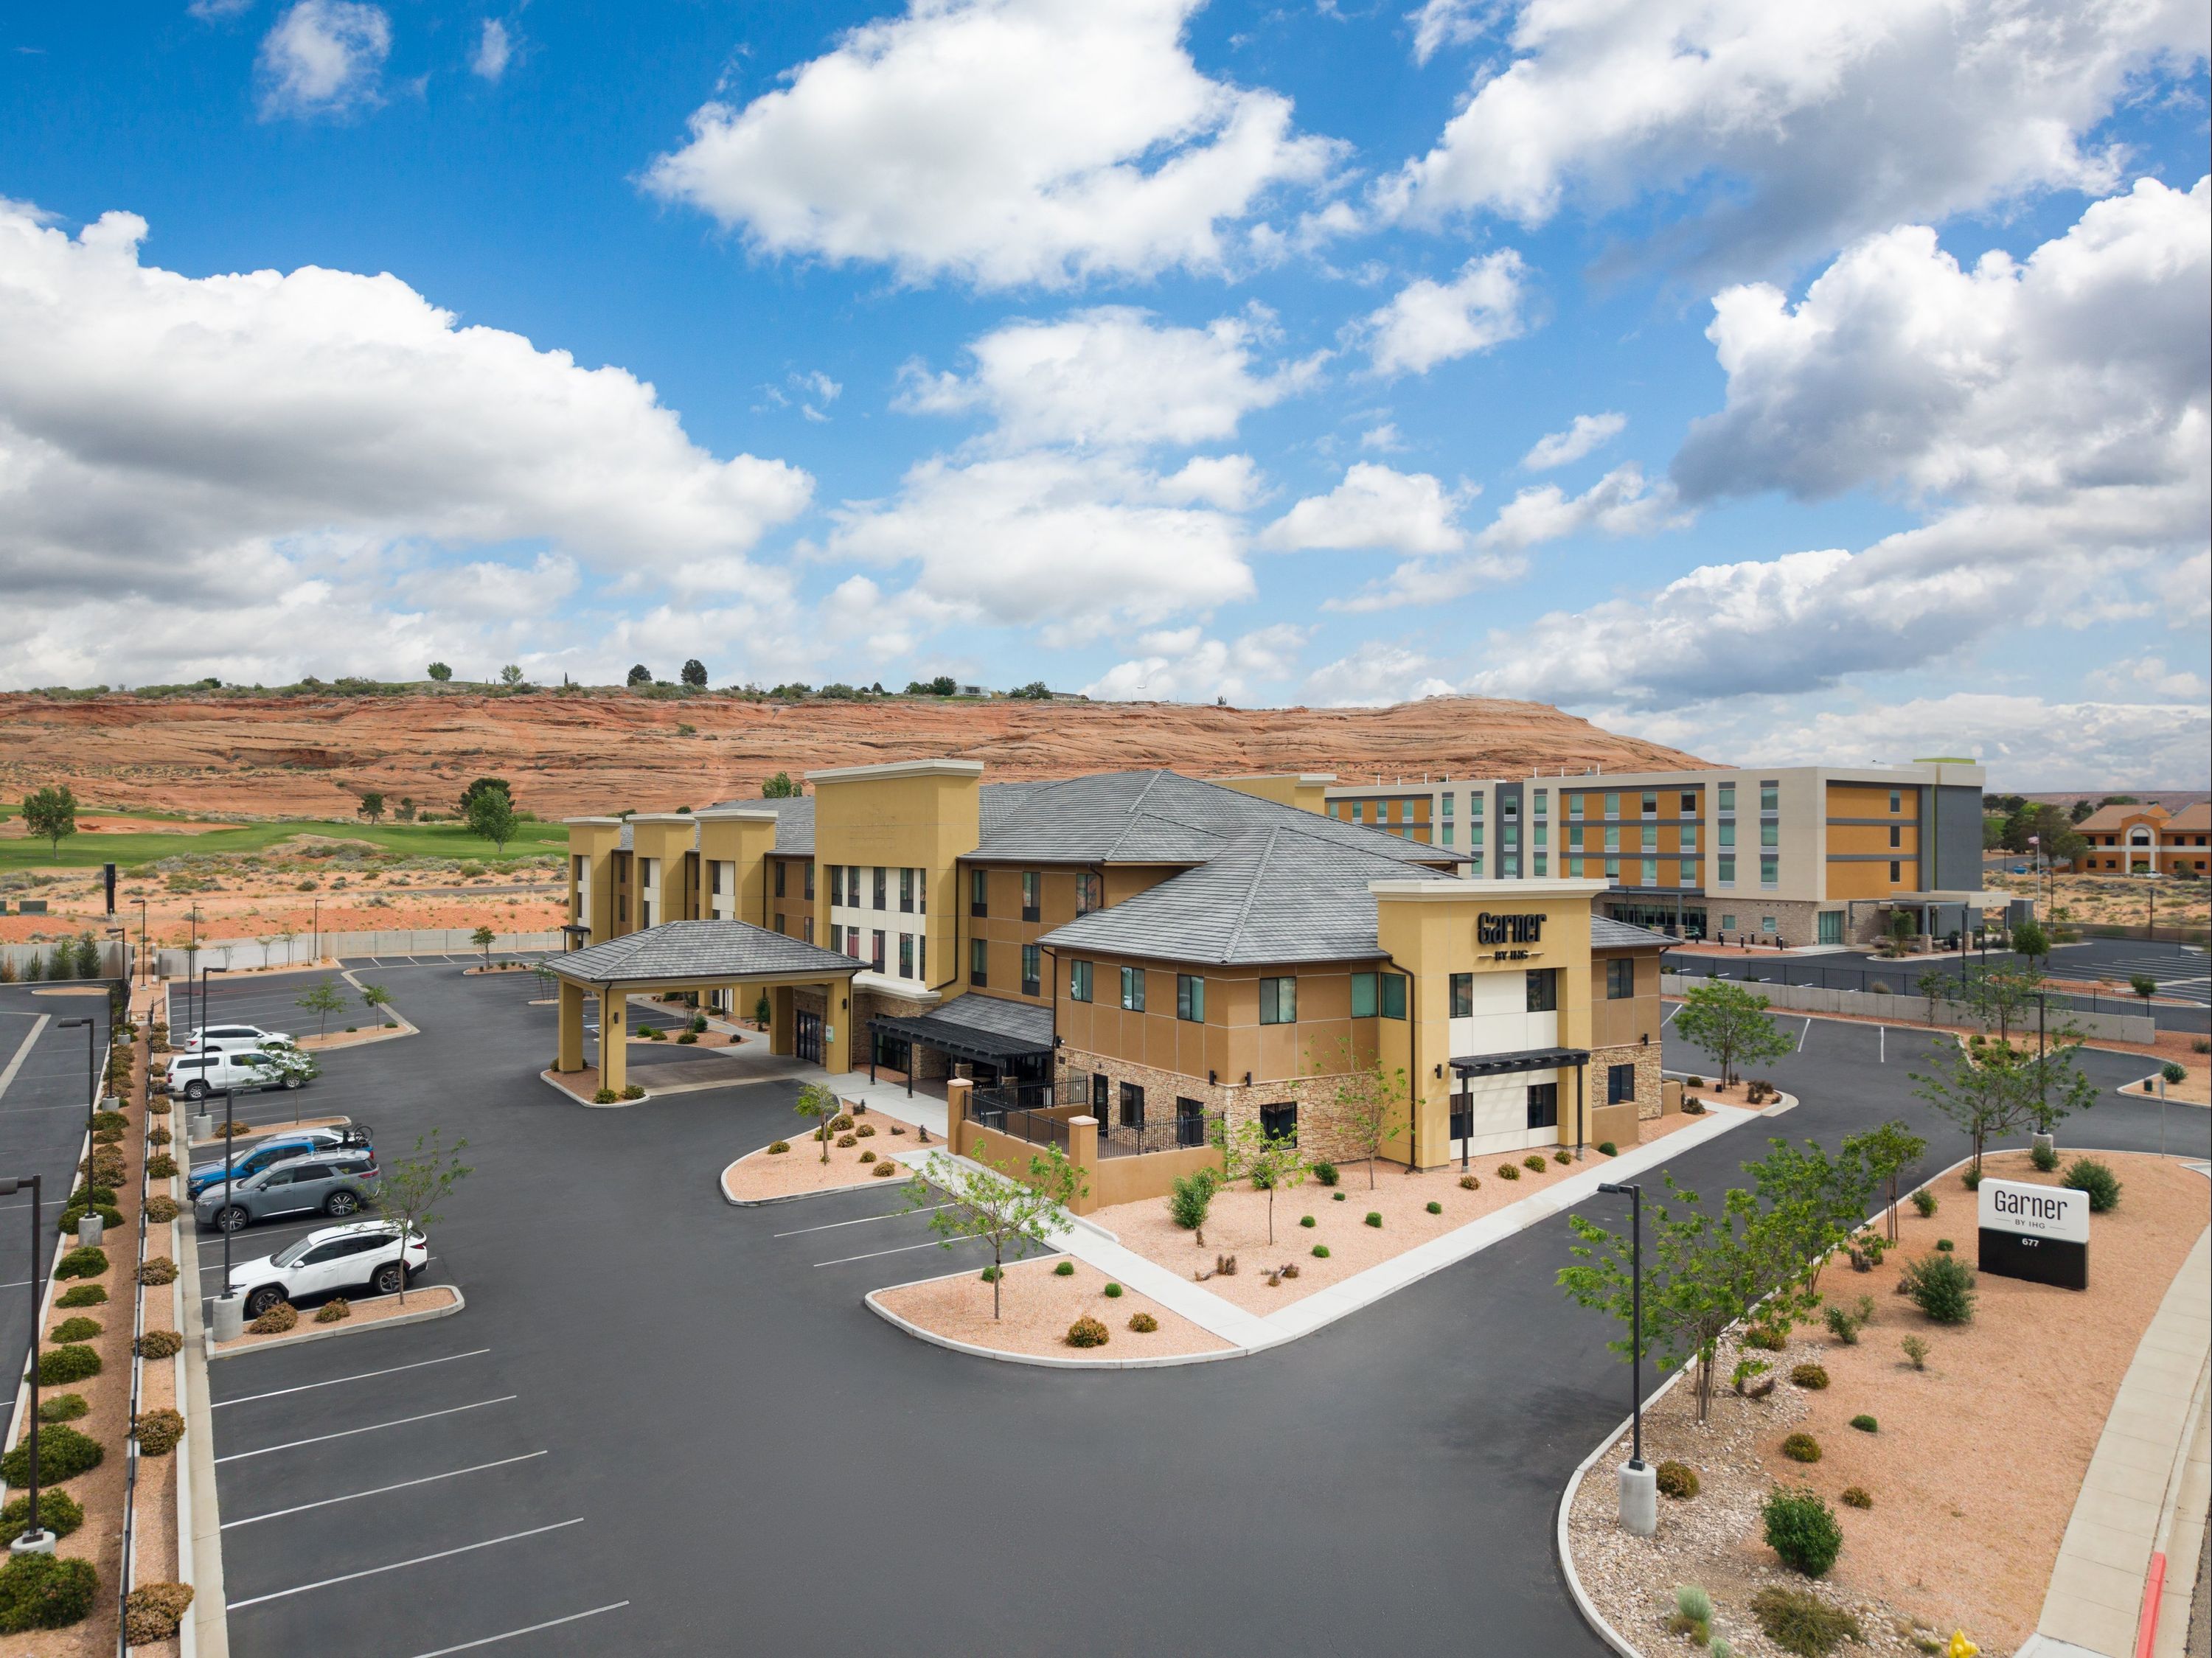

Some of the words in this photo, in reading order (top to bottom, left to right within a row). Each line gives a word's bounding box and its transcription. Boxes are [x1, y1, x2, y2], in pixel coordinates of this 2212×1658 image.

[1478, 912, 1547, 944] Garner
[1495, 951, 1508, 961] BY
[1510, 950, 1528, 960] IHG
[1994, 1190, 2068, 1220] Garner
[2028, 1221, 2045, 1229] IHG
[2022, 1238, 2039, 1247] 677
